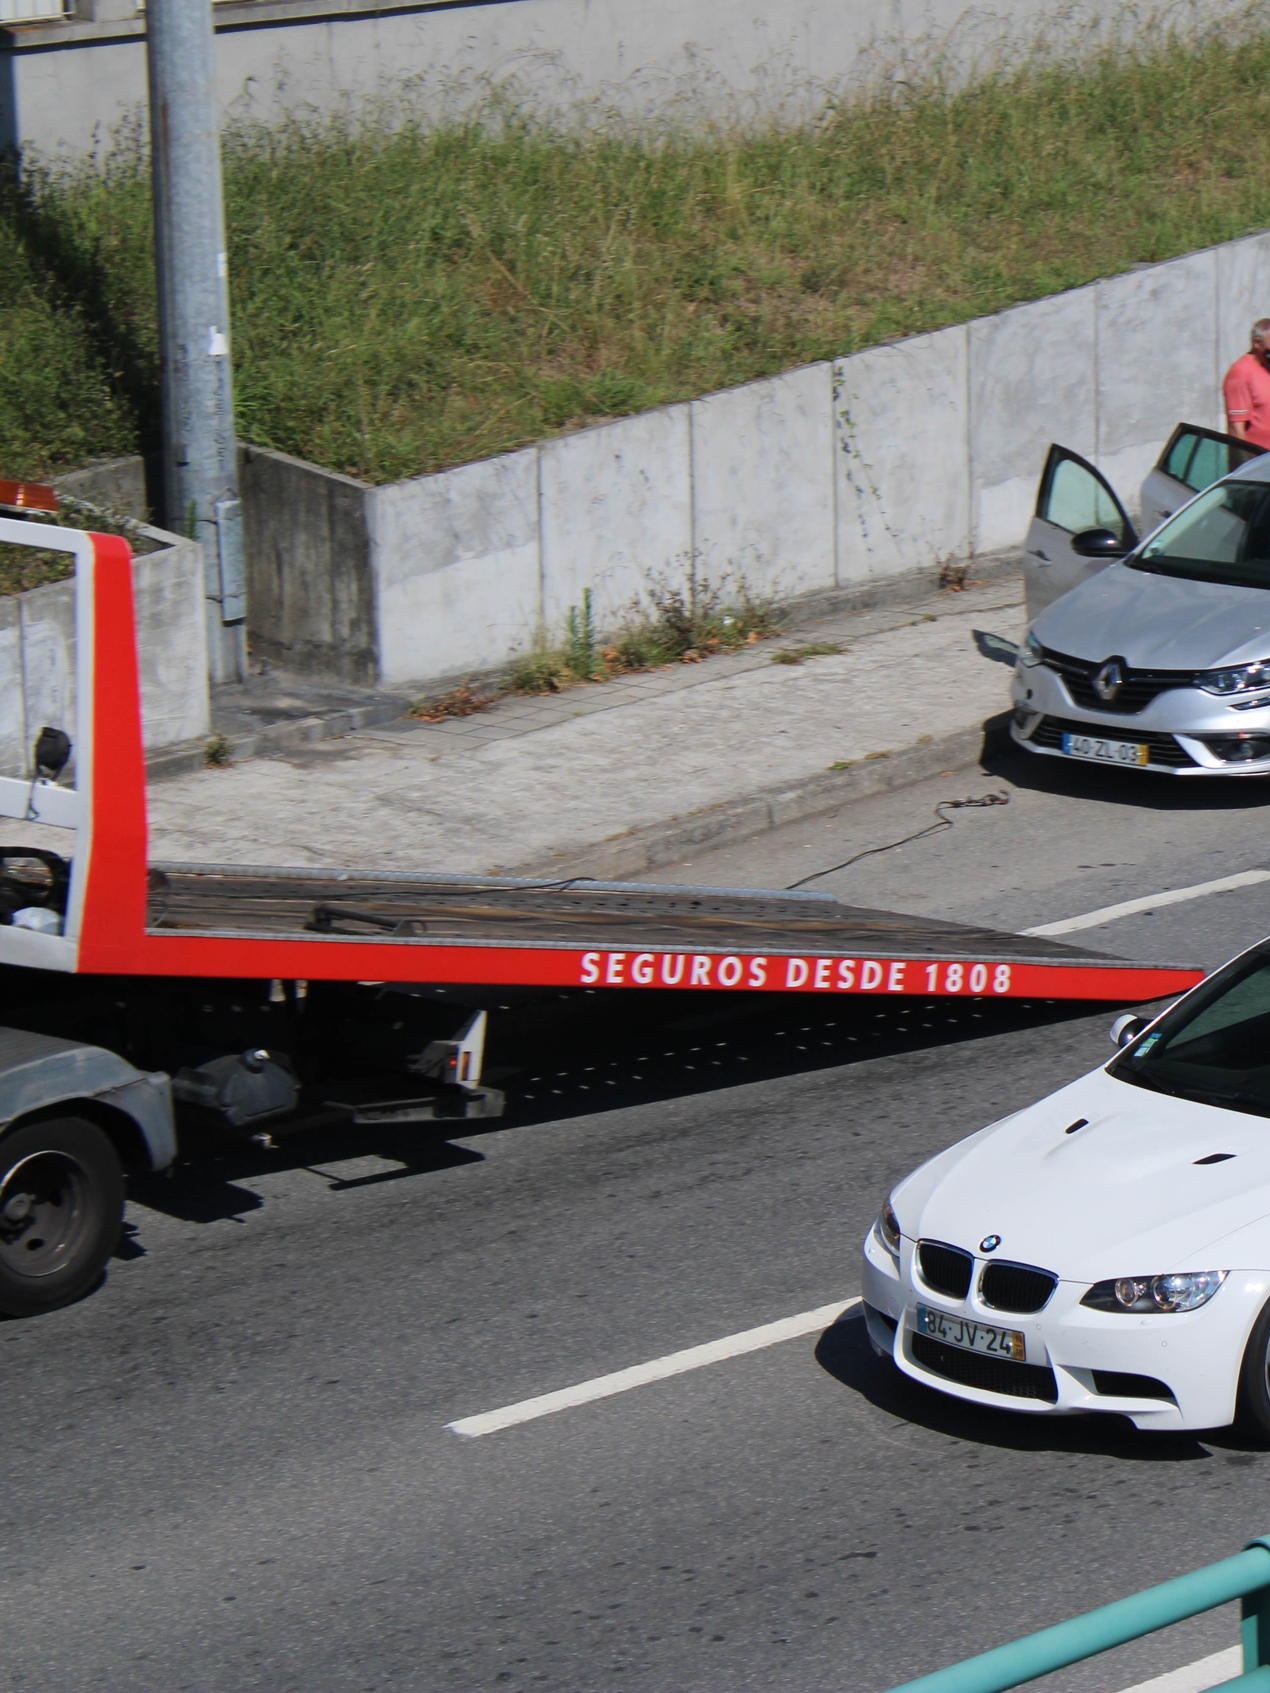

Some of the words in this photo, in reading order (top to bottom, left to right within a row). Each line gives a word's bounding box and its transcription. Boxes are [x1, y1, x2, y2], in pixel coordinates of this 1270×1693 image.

[580, 951, 768, 987] SEGUROS
[785, 958, 907, 991] DESDE
[924, 963, 1012, 993] 1808
